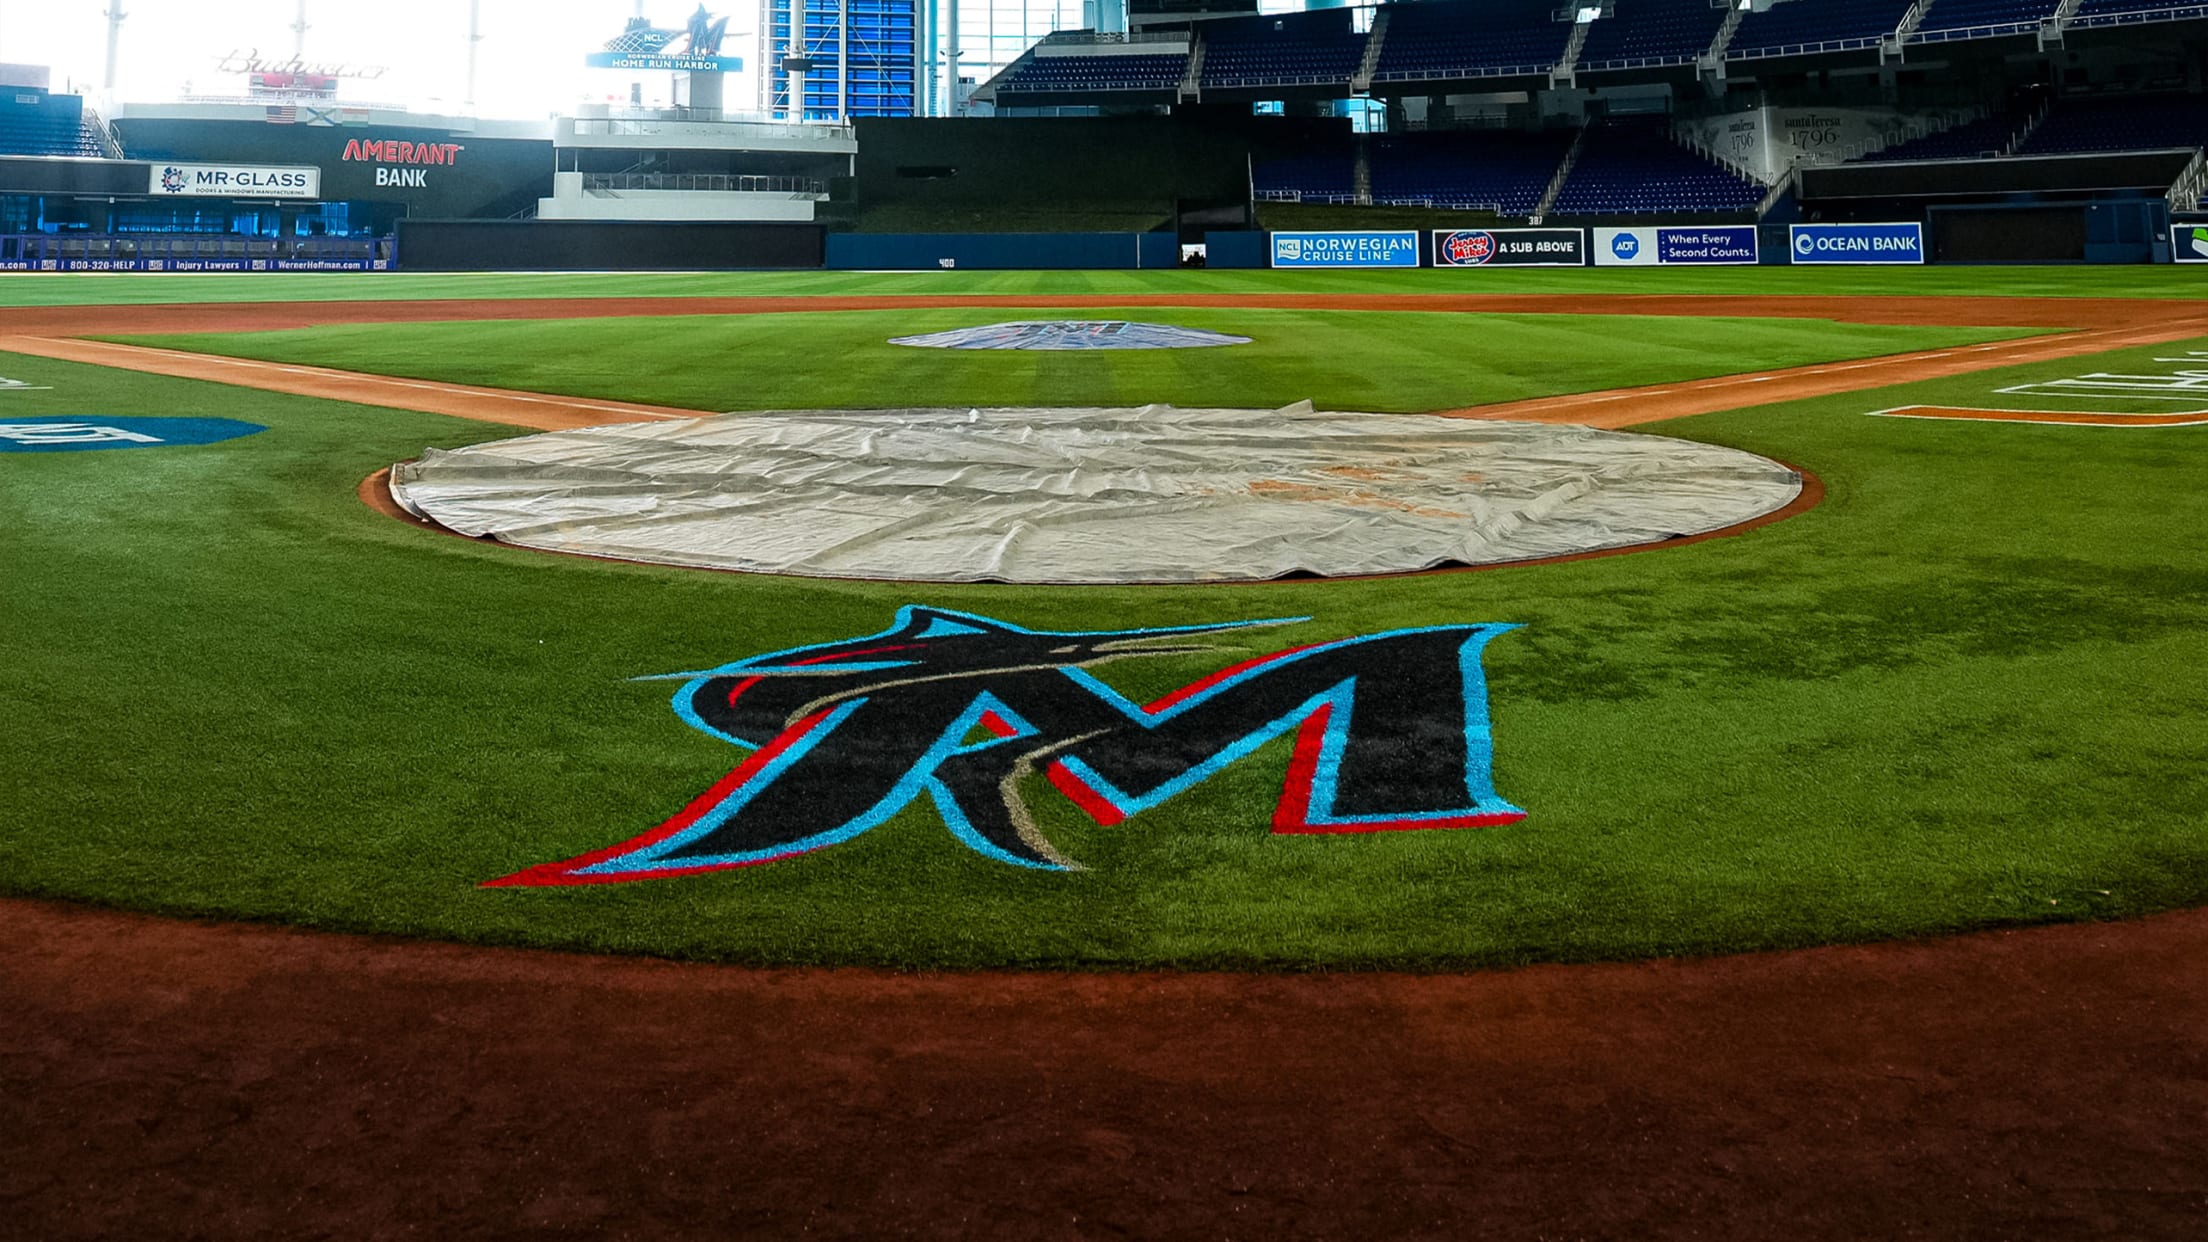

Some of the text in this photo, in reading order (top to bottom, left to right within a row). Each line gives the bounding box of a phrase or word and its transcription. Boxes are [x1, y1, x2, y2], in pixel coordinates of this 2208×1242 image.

[644, 34, 663, 42] NCL
[649, 60, 672, 68] RUN
[676, 60, 718, 70] HARBOR
[1731, 132, 1754, 153] 1796
[1790, 128, 1838, 150] 1796
[342, 138, 460, 165] AMERANT
[196, 171, 306, 187] MR-GLASS
[375, 167, 427, 187] BANK
[1303, 238, 1412, 250] NORWEGIAN
[1449, 236, 1488, 249] Jersey
[1668, 234, 1731, 245] When Every
[1816, 236, 1917, 251] OCEAN BANK
[1279, 242, 1299, 251] NCL
[1499, 241, 1574, 253] A SUB ABOVE
[1615, 241, 1636, 251] ADT
[1303, 250, 1391, 261] CRUISE LINE
[1669, 247, 1754, 257] Second Counts.
[70, 260, 136, 270] 800-320-HELP
[176, 260, 240, 270] Injury Lawyers
[278, 260, 361, 270] WernerHoffman.com
[938, 258, 955, 268] 400
